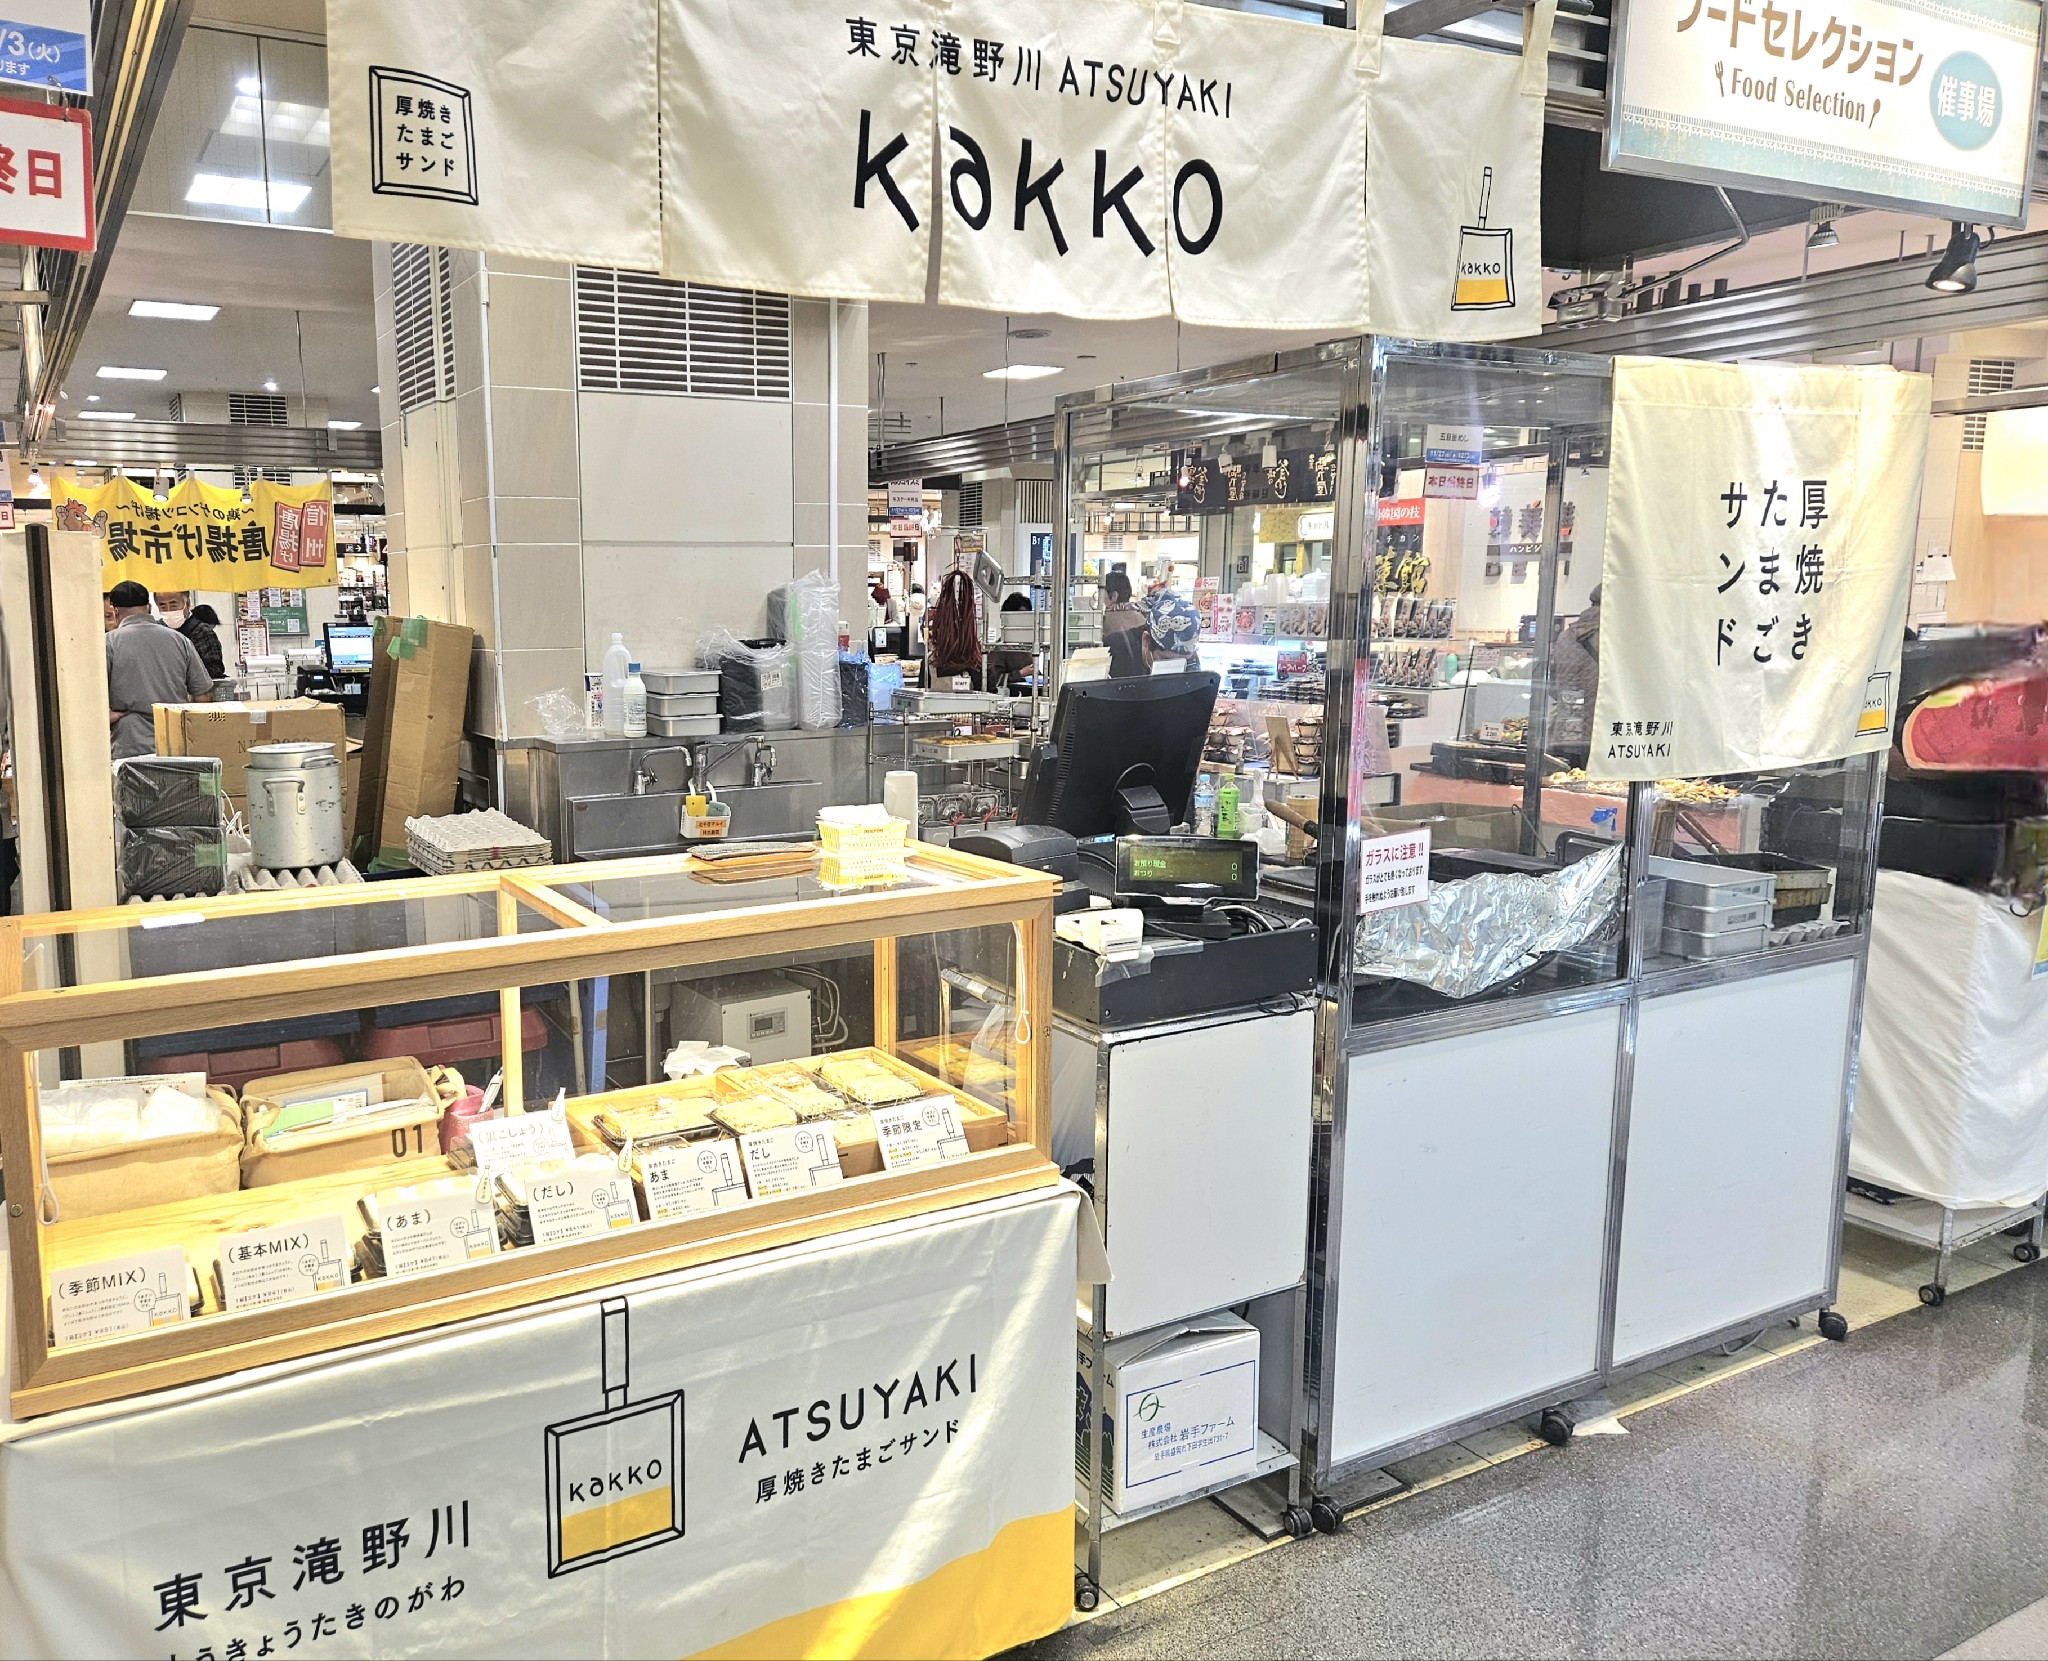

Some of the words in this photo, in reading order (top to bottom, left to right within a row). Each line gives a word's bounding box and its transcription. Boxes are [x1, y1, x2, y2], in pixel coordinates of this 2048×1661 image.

[845, 17, 1041, 90] 東京滝野川
[1059, 55, 1232, 118] ATSUYAKI
[395, 95, 453, 122] 厚焼き
[1731, 67, 1777, 103] Food
[1784, 80, 1865, 123] Selection
[1937, 74, 1996, 128] 催事場
[396, 123, 455, 150] たまご
[396, 151, 455, 178] サンド
[1716, 481, 1748, 666] サンド
[1753, 479, 1789, 662] たまご
[1791, 480, 1829, 660] 厚焼き
[1610, 721, 1673, 736] 東京滝野川
[1608, 743, 1671, 759] ATSUYAKI
[1133, 860, 1166, 868] お預り現金
[1231, 862, 1237, 870] 0
[391, 1127, 424, 1158] 01
[882, 1120, 922, 1137] 季節限定
[750, 1148, 771, 1160] だし
[650, 1169, 670, 1183] あま
[533, 1181, 574, 1202] (だし)
[386, 1208, 431, 1231] (あま)
[228, 1233, 309, 1263] (基本MIX)
[59, 1266, 146, 1299] (季節MIX)
[739, 1353, 977, 1464] ATSUYAKI
[1179, 1416, 1235, 1441] 岩手ファーム
[755, 1419, 960, 1504] 厚焼きたまごサンド
[153, 1500, 470, 1631] 東京滝野川
[170, 1576, 465, 1660] うきょうたきのがわ
